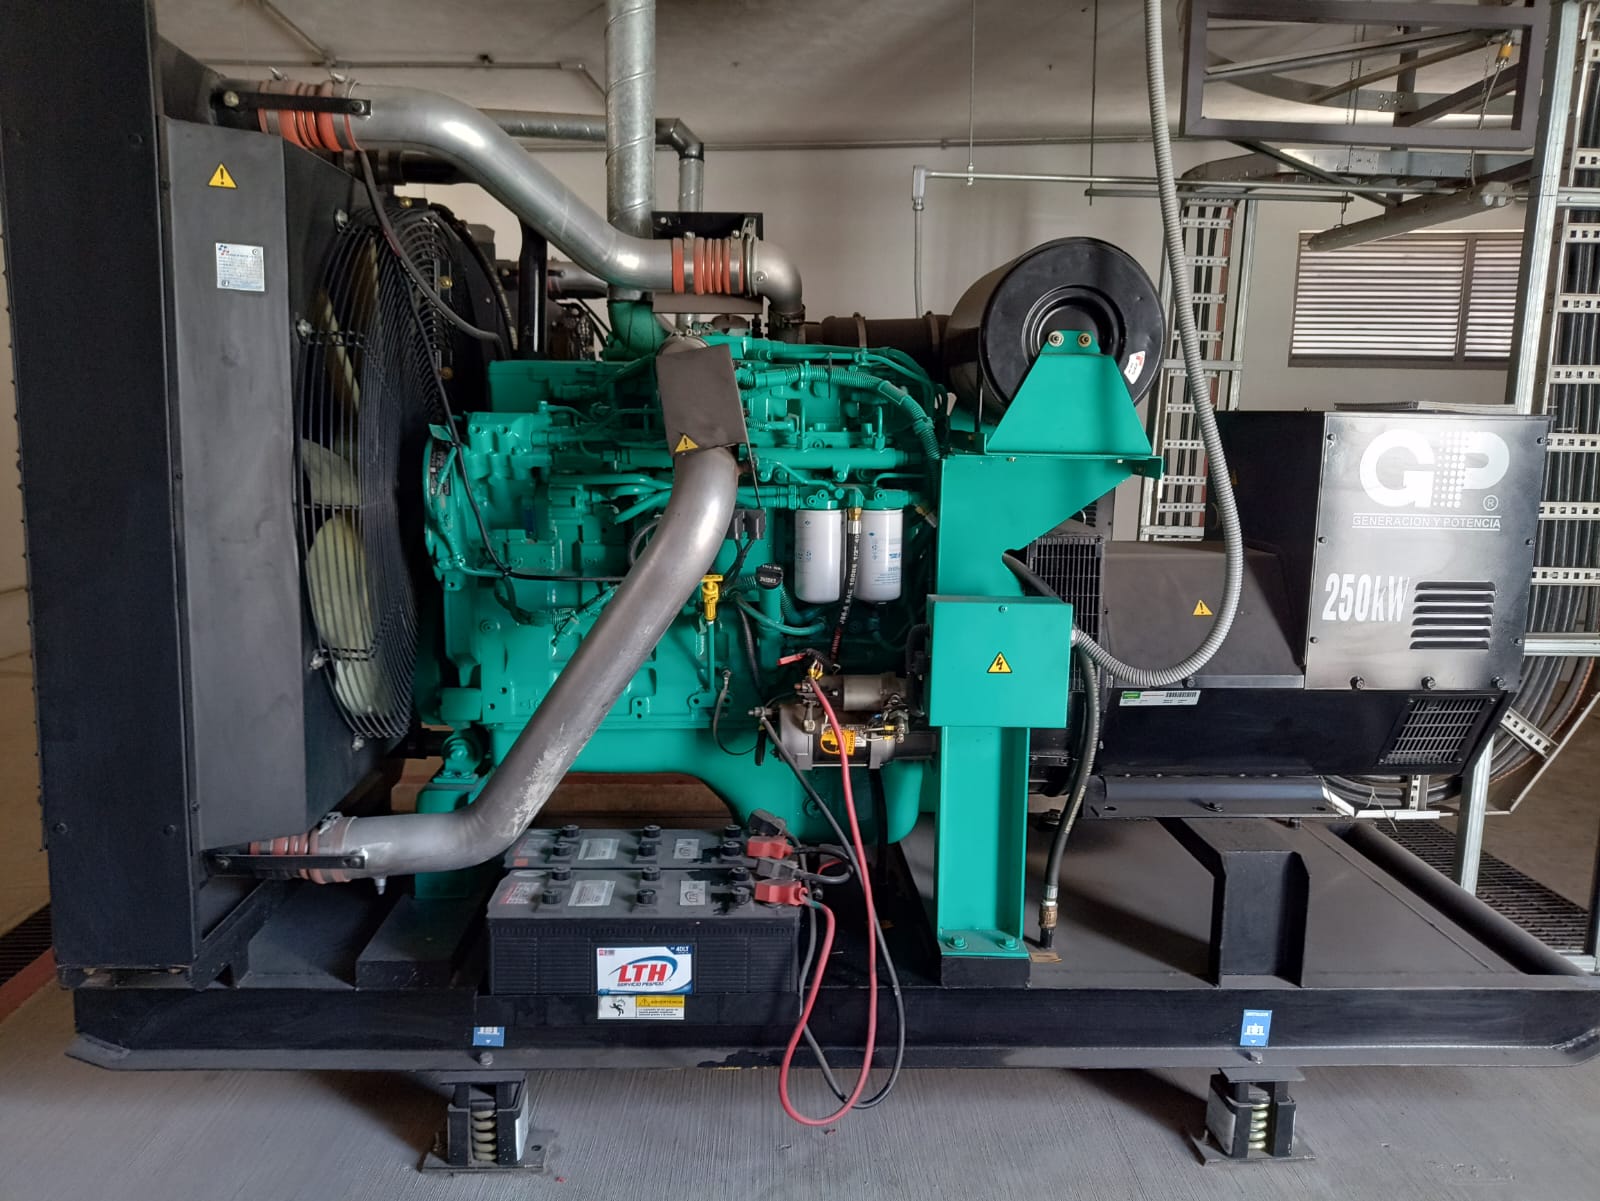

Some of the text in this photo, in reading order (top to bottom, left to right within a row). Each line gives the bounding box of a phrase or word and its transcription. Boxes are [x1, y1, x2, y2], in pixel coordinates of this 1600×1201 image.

[1431, 517, 1440, 528] Y
[1443, 517, 1501, 529] POTENCIA
[1321, 573, 1410, 622] 250kW
[618, 964, 668, 982] LTH
